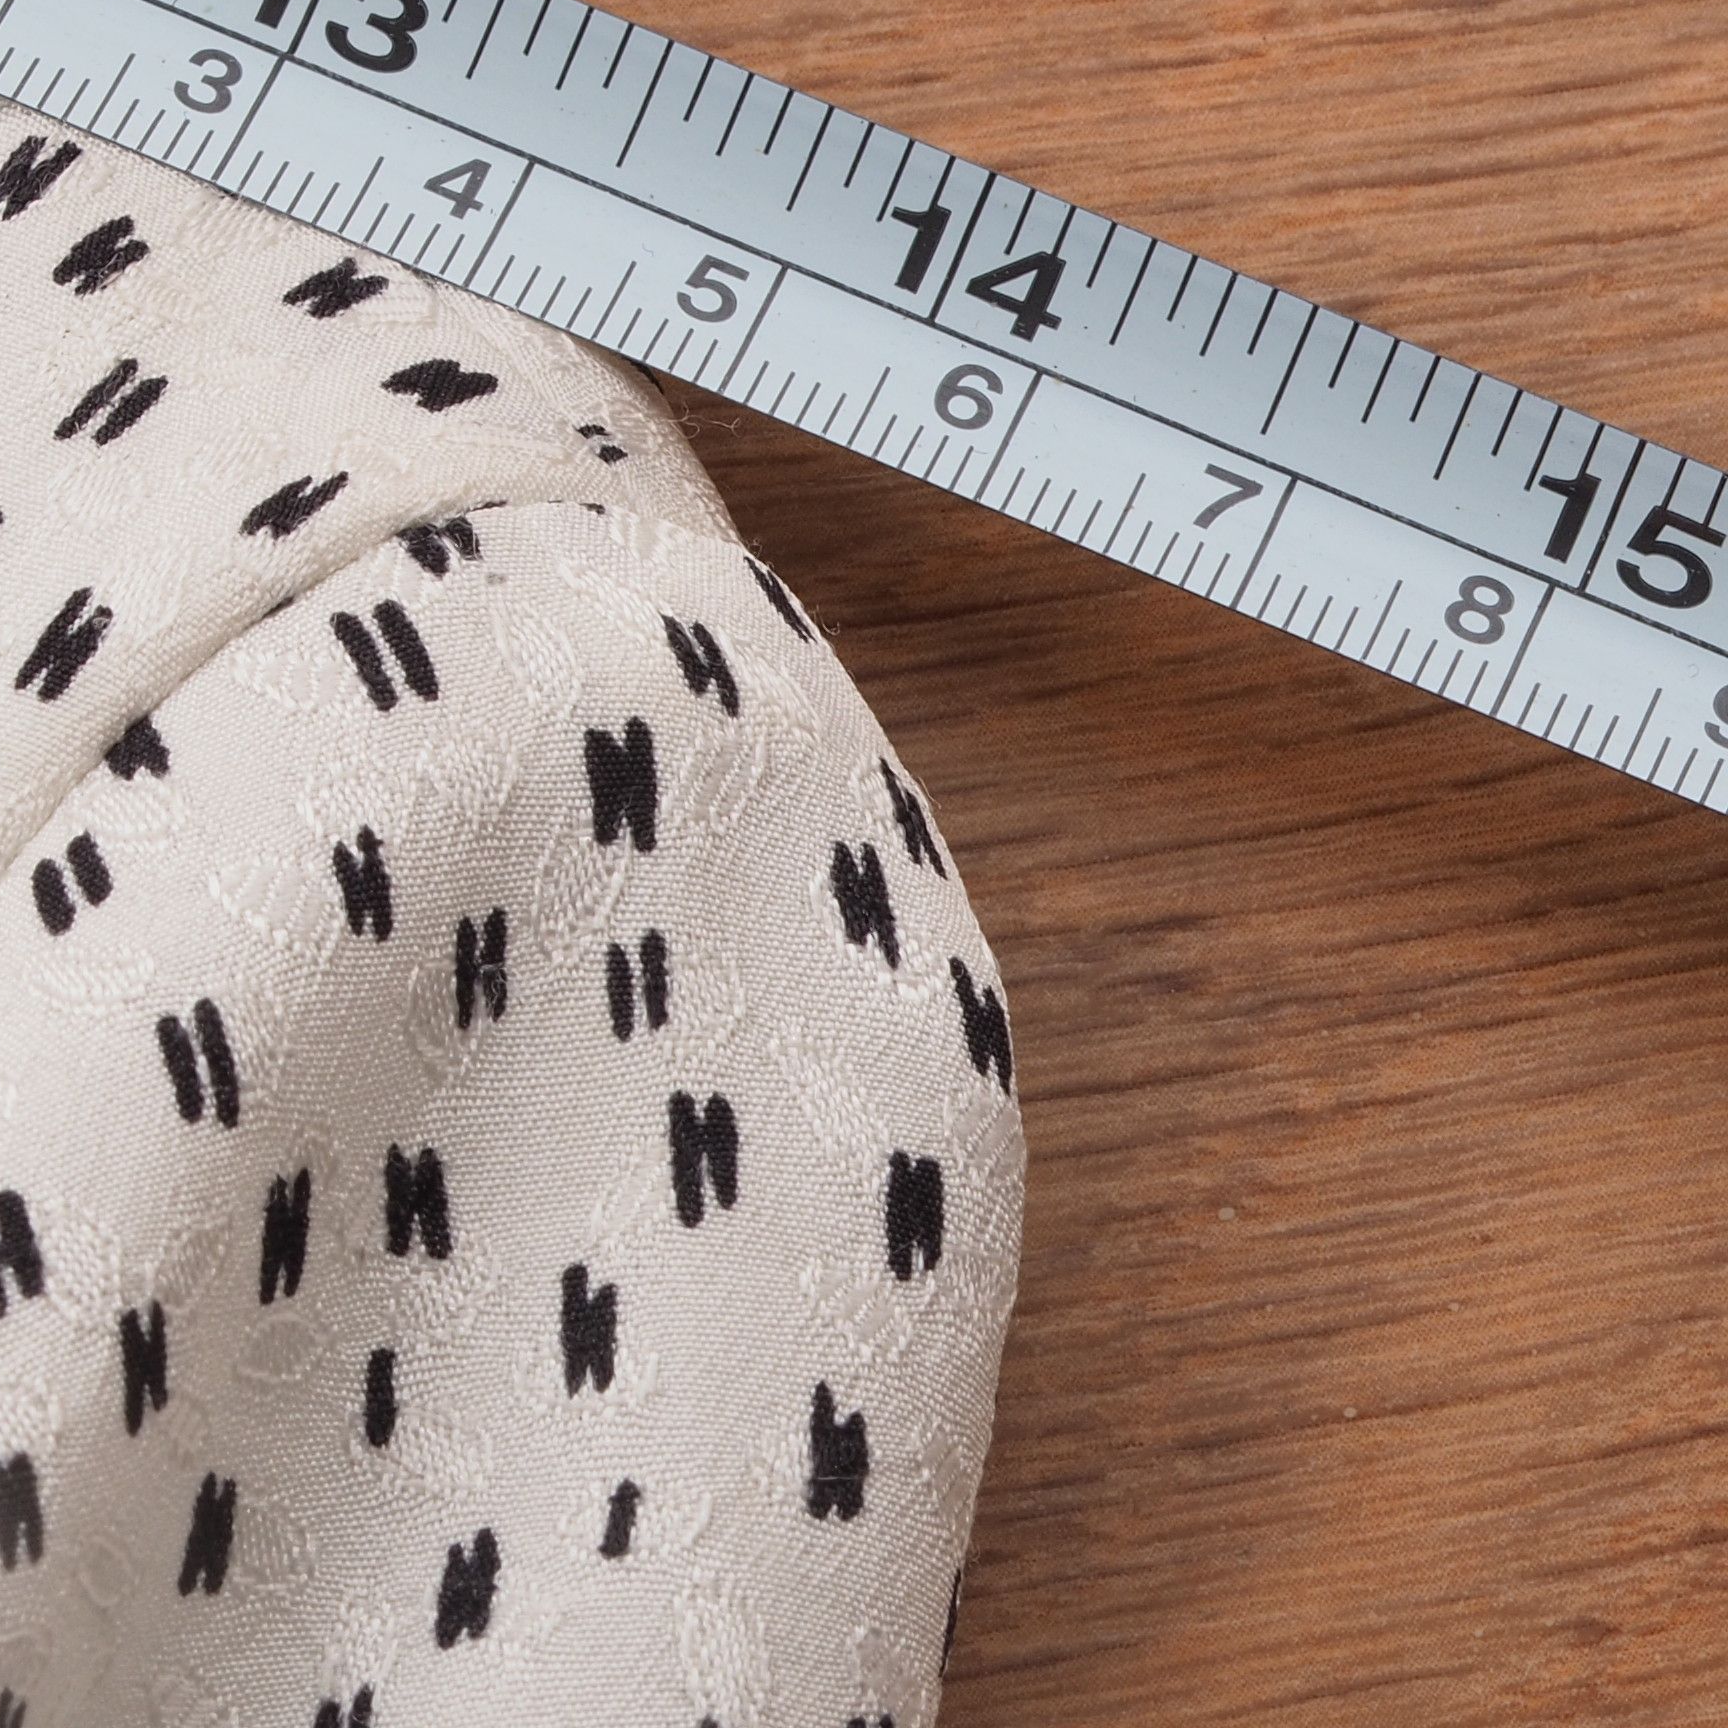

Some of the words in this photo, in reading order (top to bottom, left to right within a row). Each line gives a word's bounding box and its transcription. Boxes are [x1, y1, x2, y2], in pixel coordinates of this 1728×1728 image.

[172, 48, 245, 115] 3
[422, 158, 493, 219] 4
[675, 254, 750, 324] 5
[890, 201, 1068, 342] 14
[933, 364, 1005, 430] 6
[1192, 463, 1265, 530] 7
[1537, 472, 1727, 609] 15
[1443, 574, 1516, 646] 8
